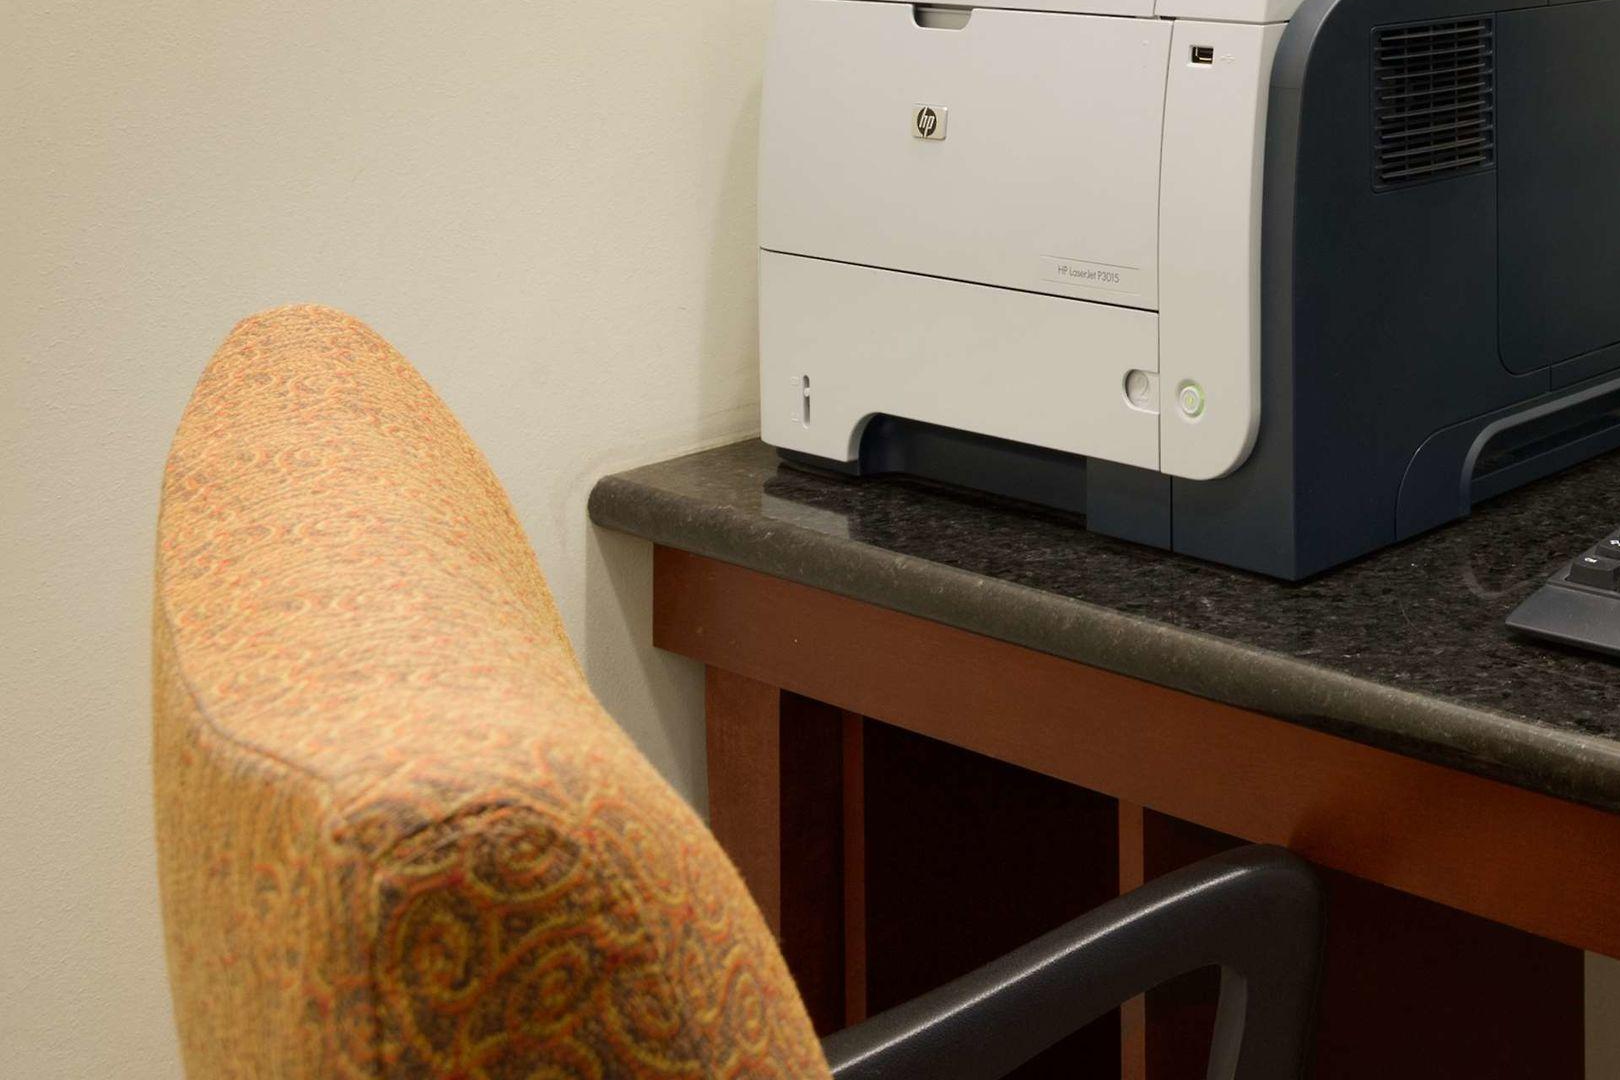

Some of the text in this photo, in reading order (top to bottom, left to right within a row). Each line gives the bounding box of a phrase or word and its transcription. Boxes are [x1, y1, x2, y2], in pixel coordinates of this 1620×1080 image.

[1057, 265, 1120, 283] HP LaserJet P3015
